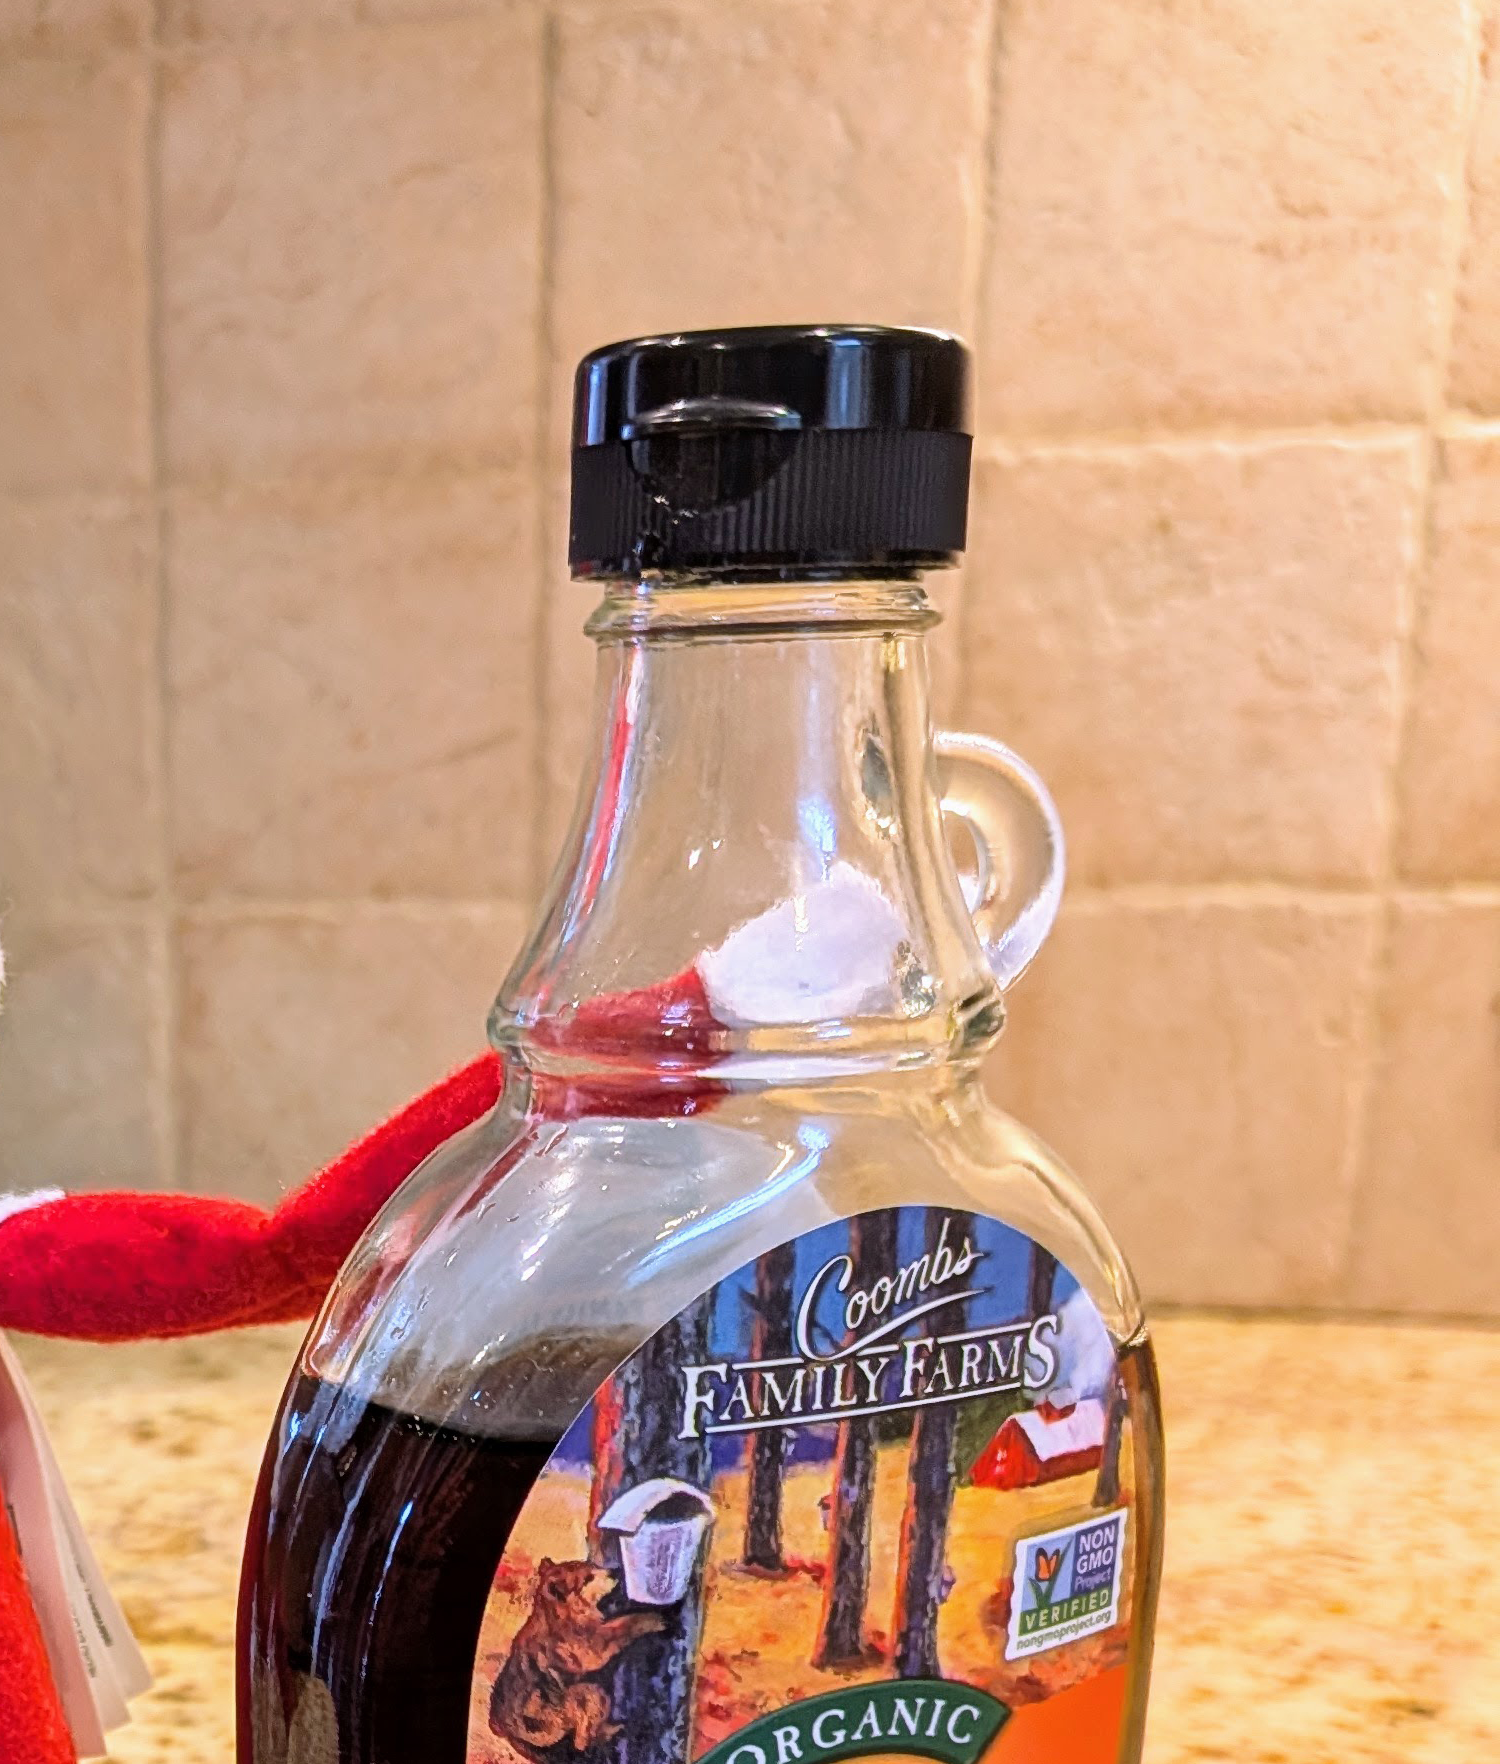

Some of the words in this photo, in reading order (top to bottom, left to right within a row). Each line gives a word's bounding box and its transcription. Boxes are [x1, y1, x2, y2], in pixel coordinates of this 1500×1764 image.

[797, 1217, 985, 1360] Coombs
[677, 1357, 889, 1440] FAMILY
[900, 1315, 1057, 1398] FARMS
[1079, 1524, 1115, 1554] NON
[1074, 1567, 1112, 1591] Project
[1077, 1546, 1114, 1574] GMO
[1026, 1589, 1109, 1630] VERIFIED
[1016, 1610, 1111, 1650] nongmoproject.org
